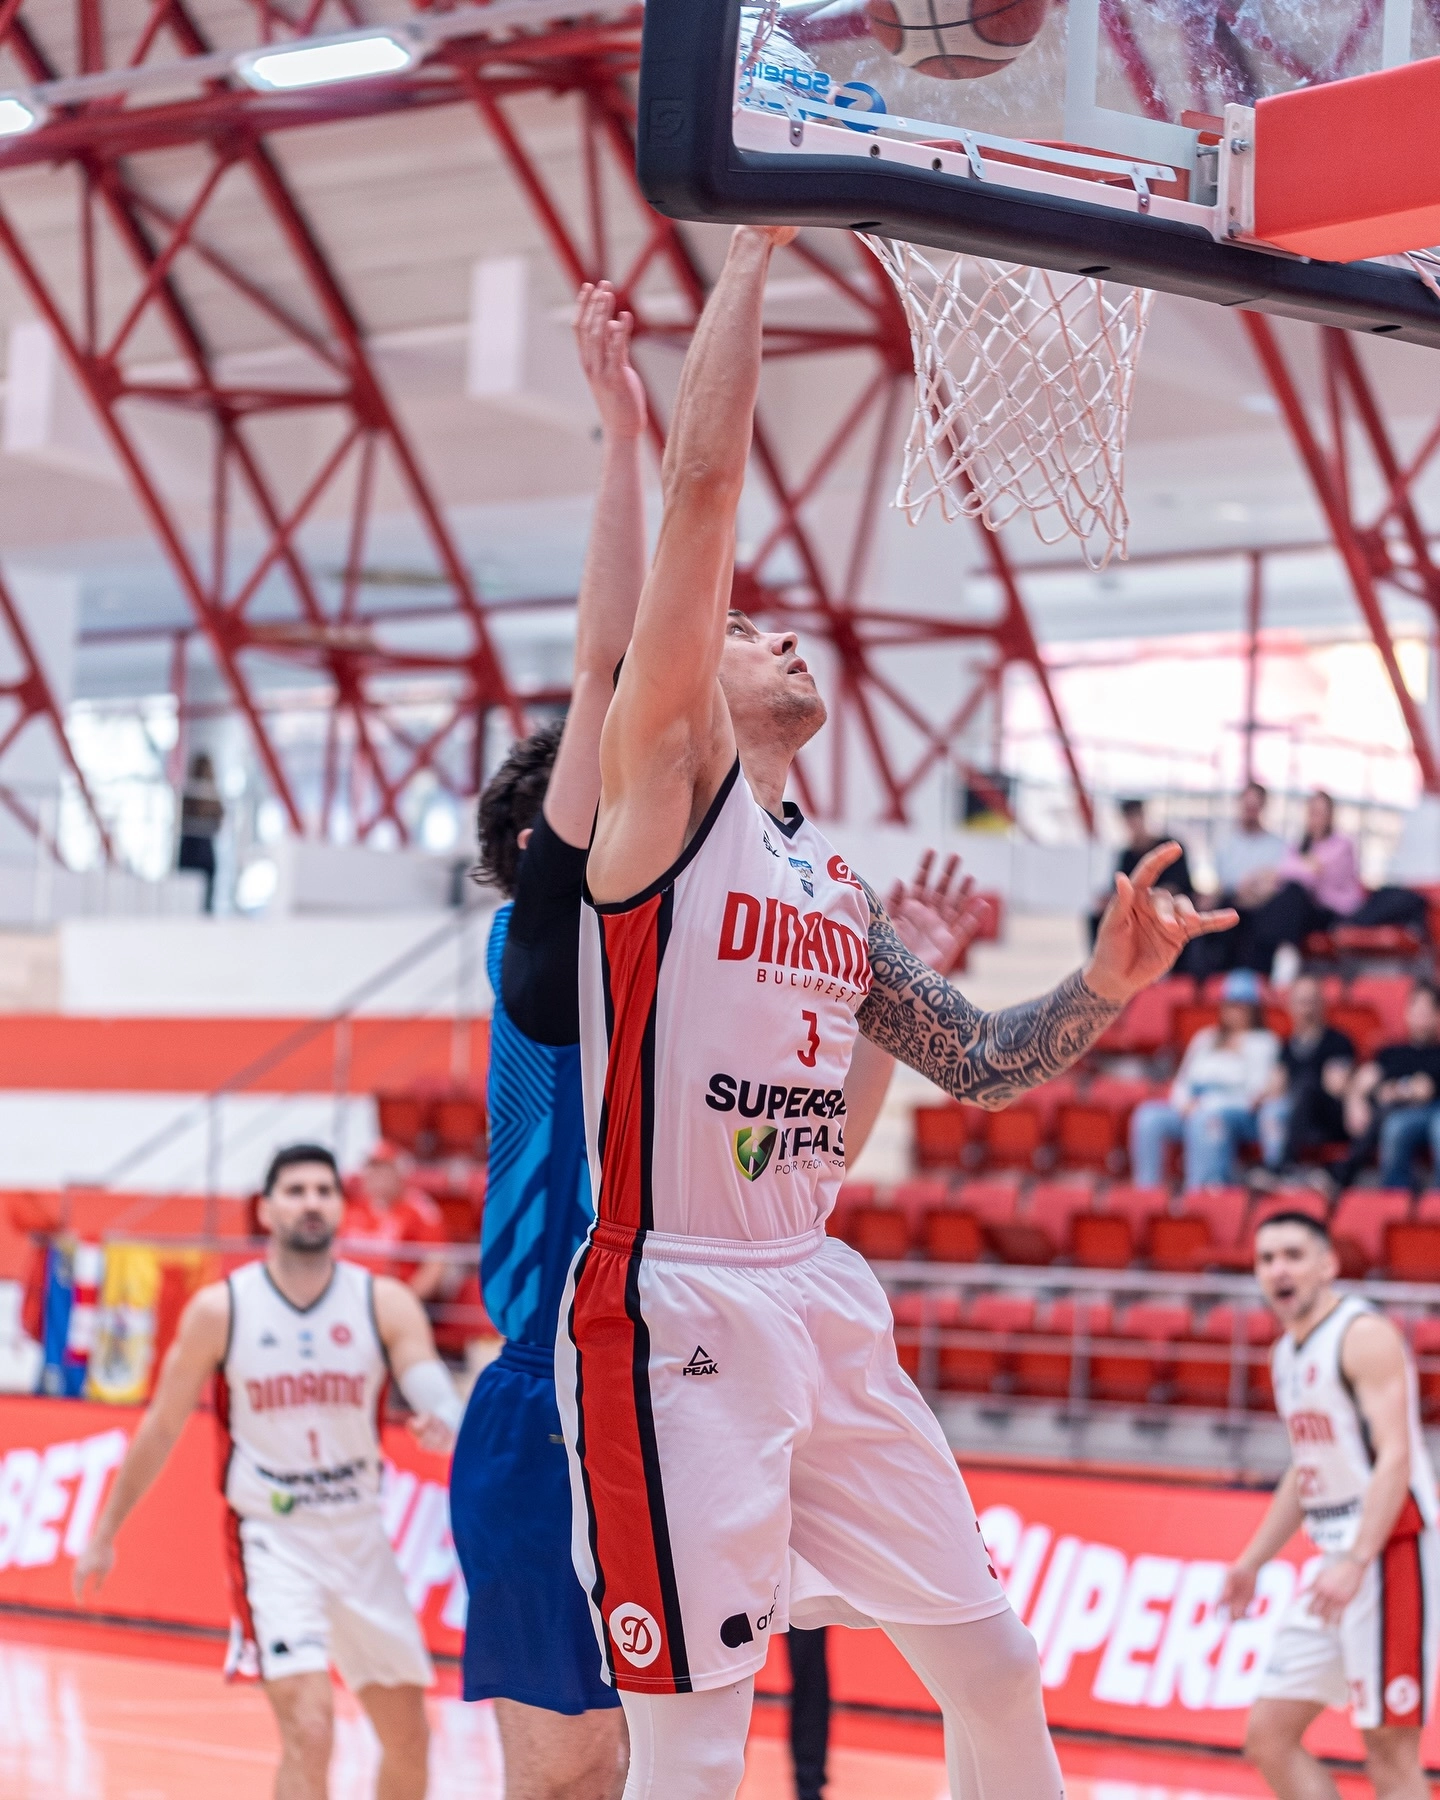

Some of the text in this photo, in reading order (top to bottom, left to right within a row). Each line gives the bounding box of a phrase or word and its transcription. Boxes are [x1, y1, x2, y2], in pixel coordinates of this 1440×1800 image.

[797, 1009, 820, 1068] 3
[682, 1362, 719, 1376] PEAK
[977, 1503, 1325, 1712] SUPERB
